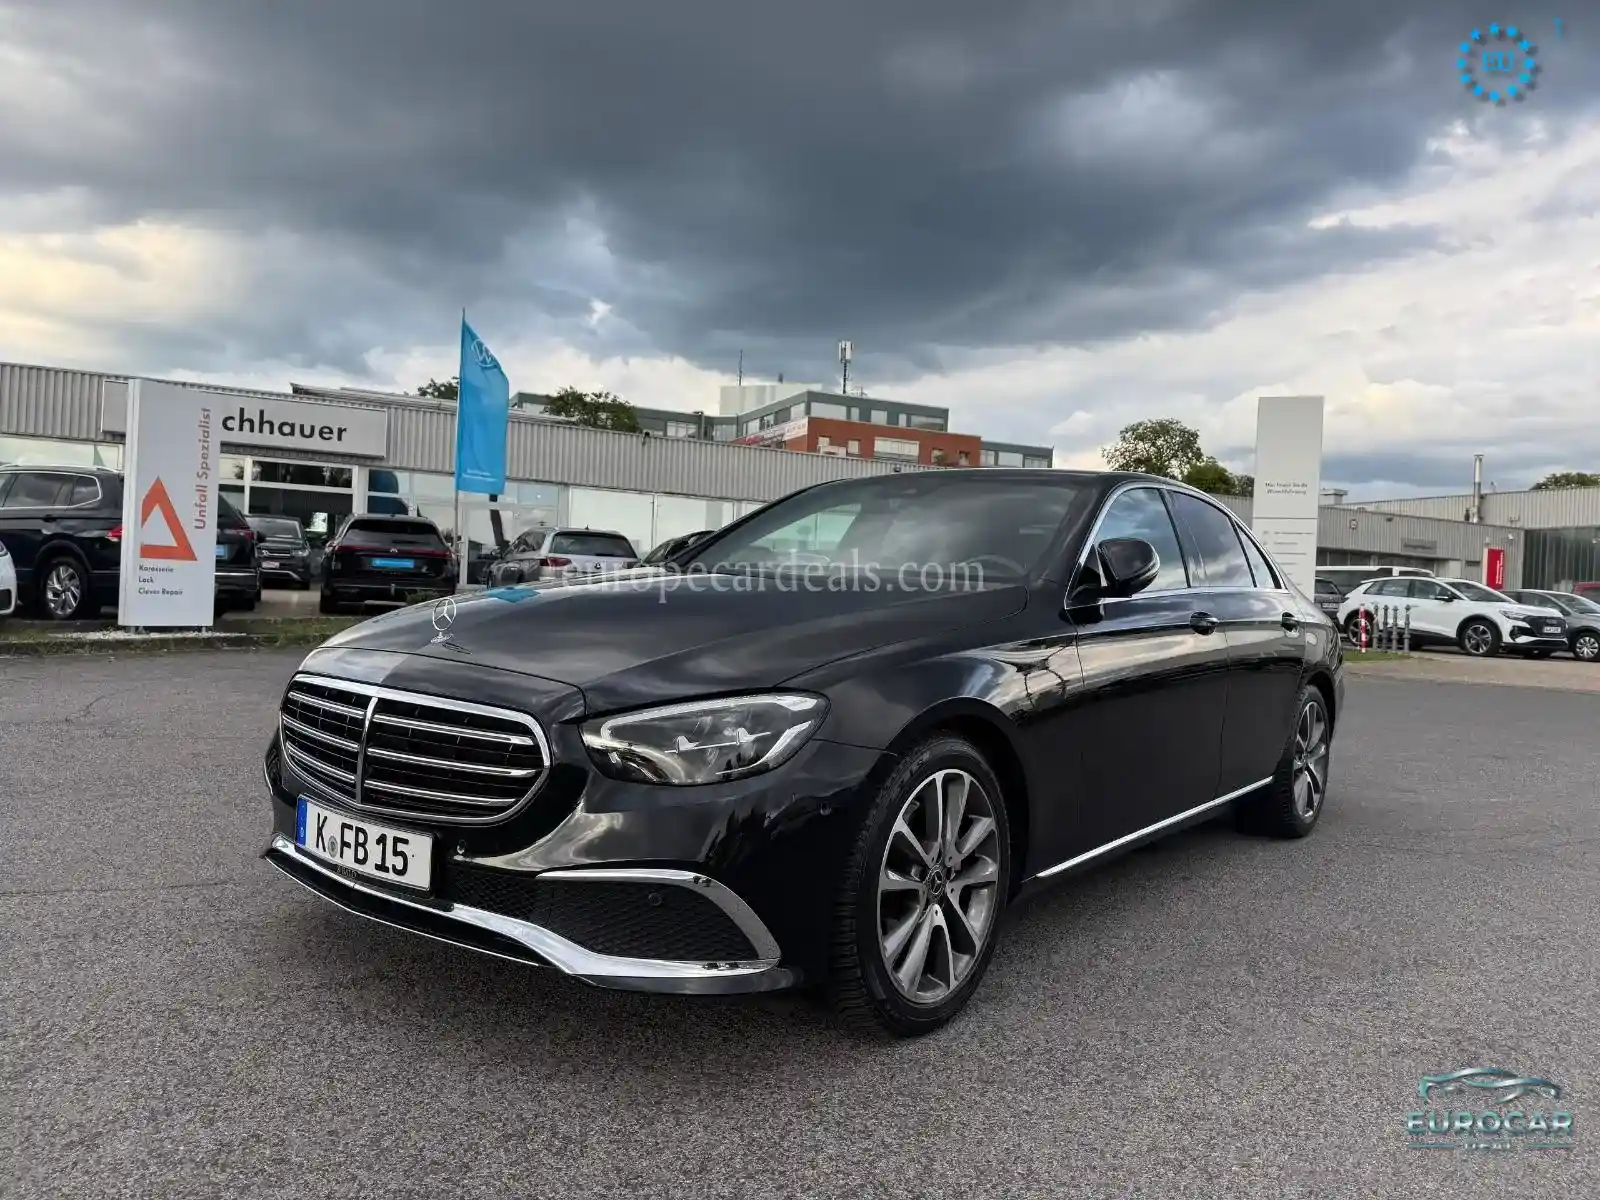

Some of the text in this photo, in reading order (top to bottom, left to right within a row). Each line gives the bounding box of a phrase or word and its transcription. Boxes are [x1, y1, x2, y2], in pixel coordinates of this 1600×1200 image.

[222, 407, 347, 441] chhauer
[194, 407, 211, 530] Unfall Spezialist
[161, 588, 184, 596] Repair
